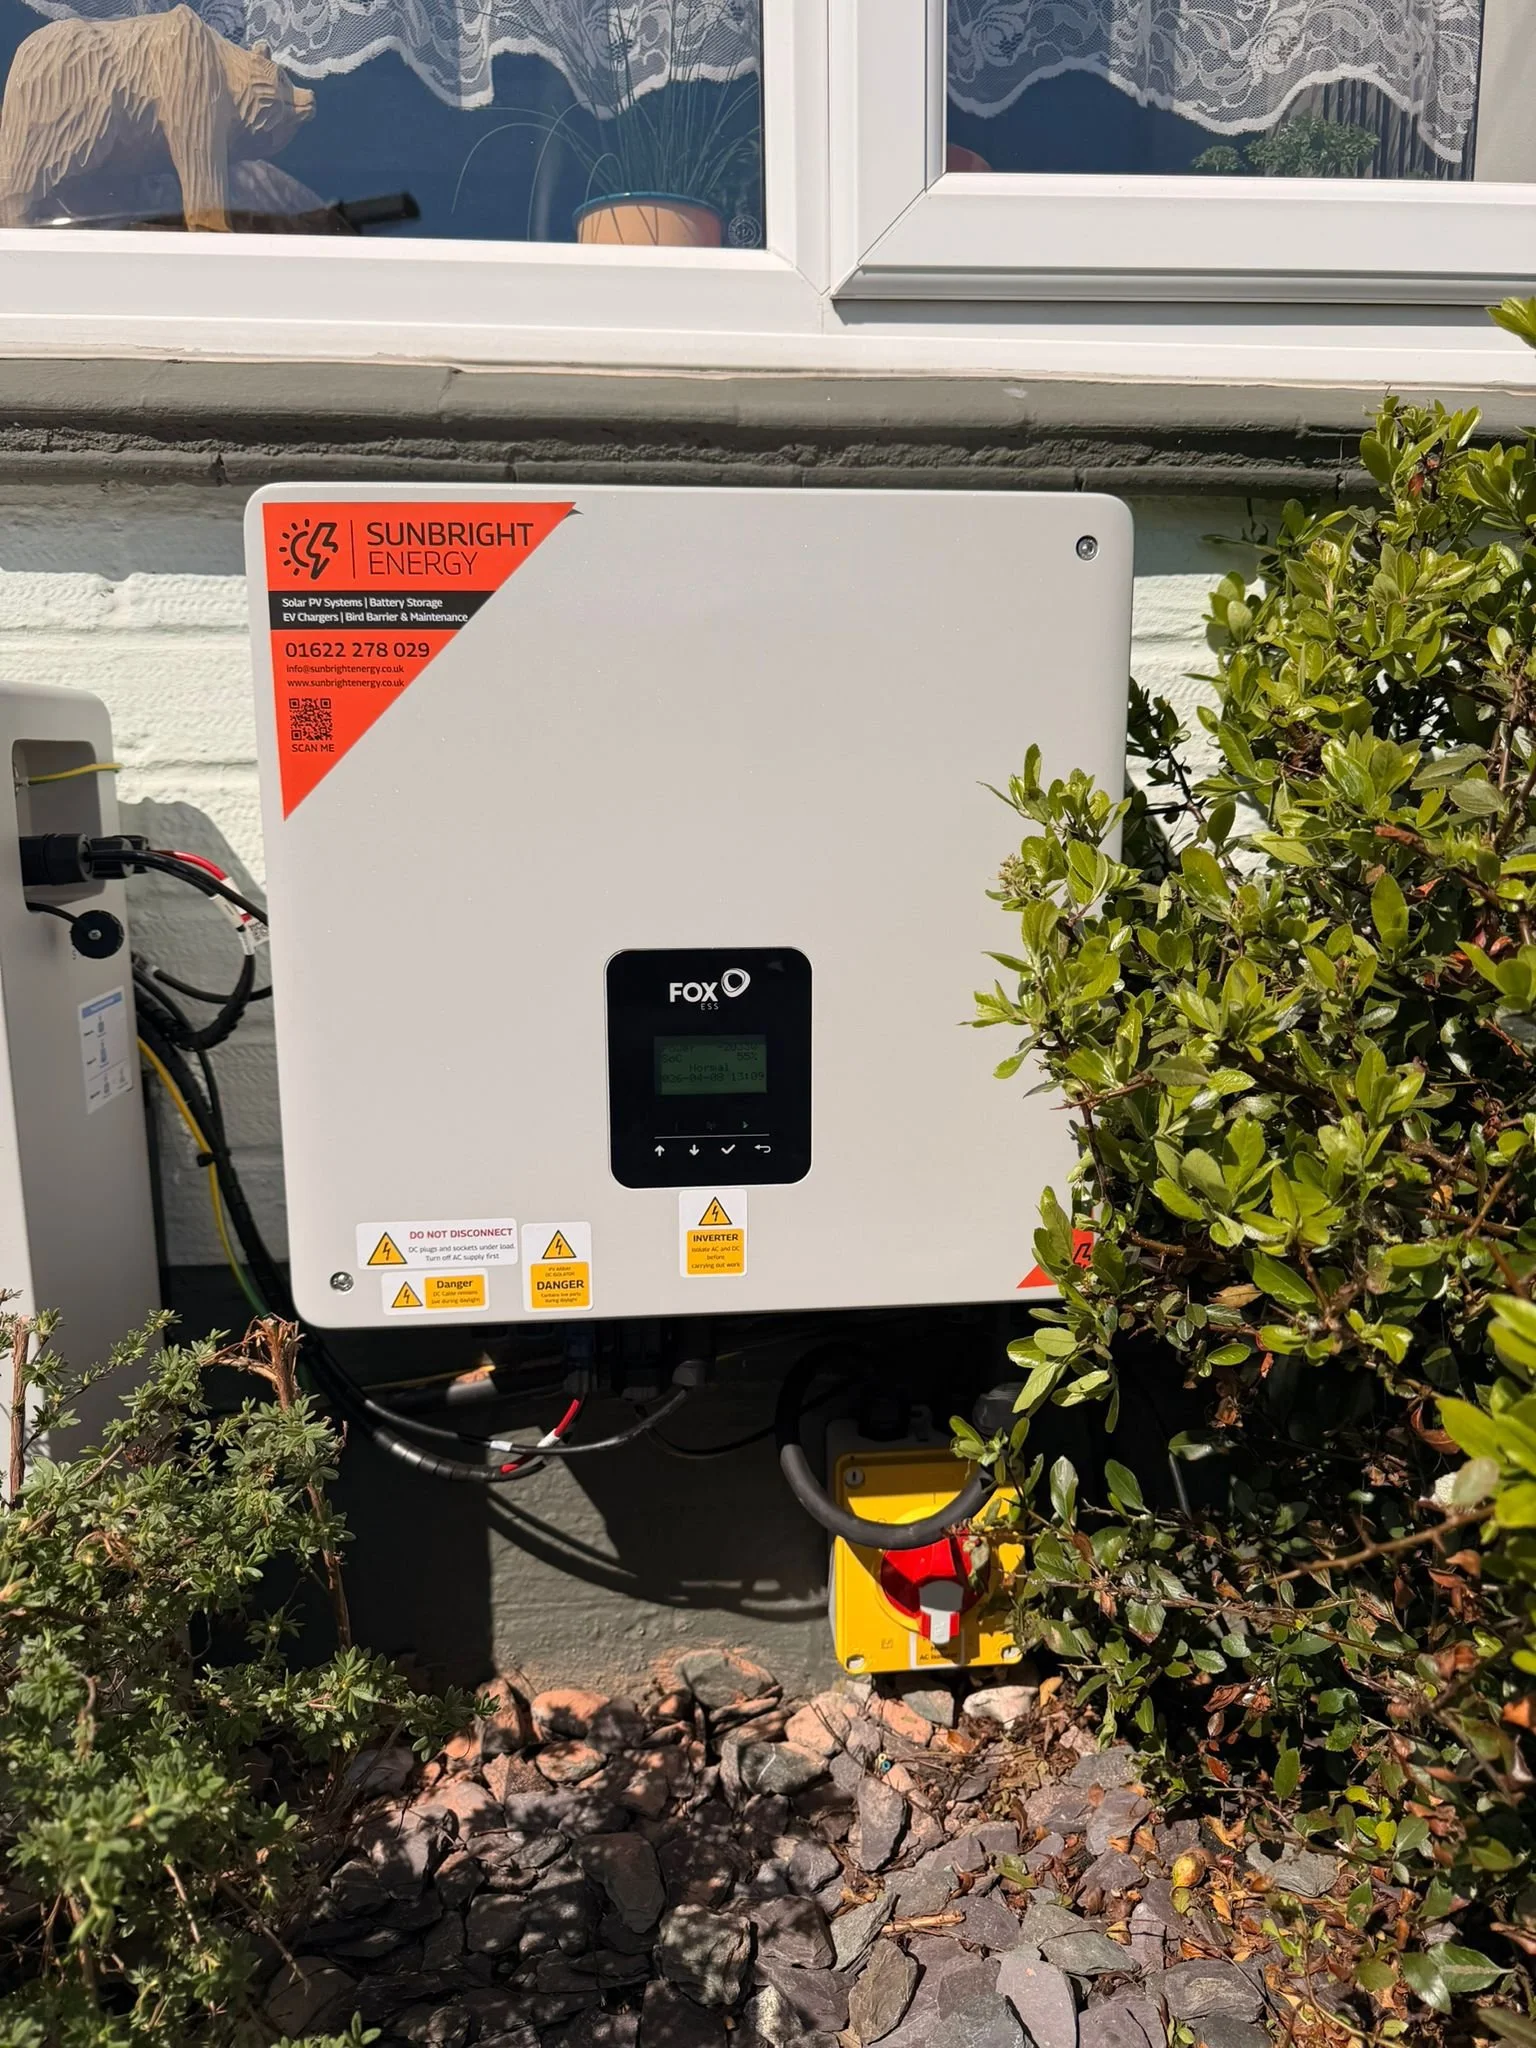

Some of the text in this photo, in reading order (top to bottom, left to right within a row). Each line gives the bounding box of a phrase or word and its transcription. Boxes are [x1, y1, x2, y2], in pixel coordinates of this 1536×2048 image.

[366, 522, 534, 547] SUNBRIGHT
[369, 551, 478, 575] ENERGY
[282, 597, 307, 608] Solar
[309, 598, 322, 608] PV
[324, 598, 363, 610] Systems
[369, 598, 405, 609] Battery
[407, 598, 443, 609] Storage
[283, 613, 297, 622] EV
[297, 612, 339, 624] Chargers
[345, 612, 365, 622] Bird
[366, 612, 399, 622] Barrier
[400, 612, 409, 622] &
[410, 612, 469, 623] Maintenance
[285, 642, 430, 658] 01622 278 029
[286, 665, 405, 675] info@sunbrightenergy.co.uk
[287, 679, 405, 688] www.sunbrightenergy.co.uk
[291, 743, 335, 753] SCAN ME
[669, 982, 719, 1003] FOX
[700, 1003, 719, 1011] ESS
[689, 1063, 729, 1072] Normal
[409, 1228, 513, 1239] DO NOT DISCONNECT
[693, 1234, 739, 1242] INVERTER
[419, 1246, 437, 1254] plugs
[463, 1254, 485, 1262] supply
[436, 1280, 473, 1289] Danger
[536, 1279, 584, 1290] DANGER
